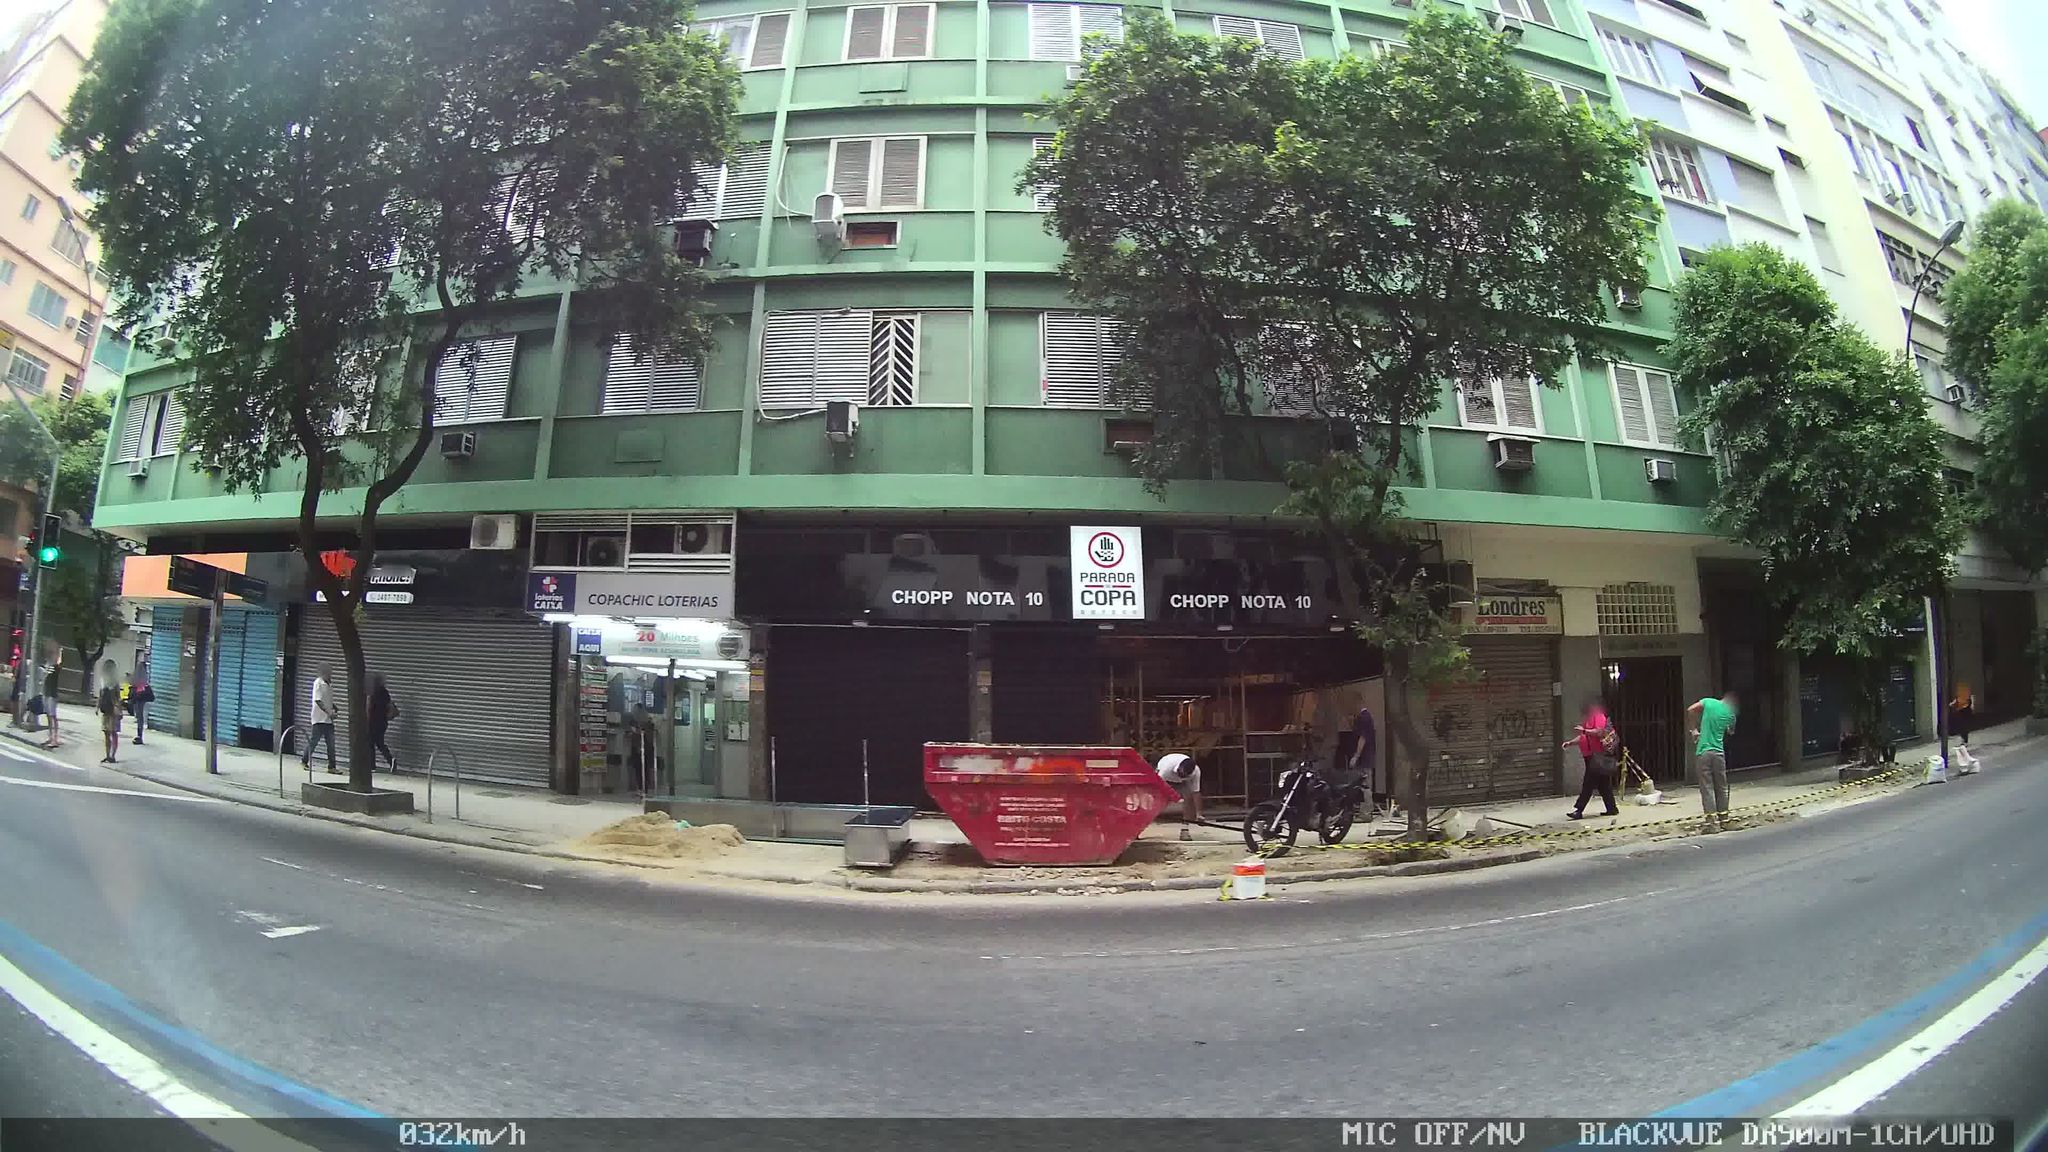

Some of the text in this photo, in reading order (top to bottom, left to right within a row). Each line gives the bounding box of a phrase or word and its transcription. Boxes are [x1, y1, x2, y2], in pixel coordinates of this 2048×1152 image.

[1080, 572, 1136, 583] PARADA
[534, 593, 564, 602] loterias
[588, 594, 719, 608] COPACHIC LOTERIAS
[891, 590, 1043, 606] CHOPP NOTA 10
[1080, 590, 1137, 606] COPA
[1170, 594, 1311, 609] CHOPP NOTA 10
[534, 601, 563, 610] CAIXA
[1478, 597, 1546, 616] Londres
[637, 631, 656, 642] 20
[579, 643, 601, 653] AQUI
